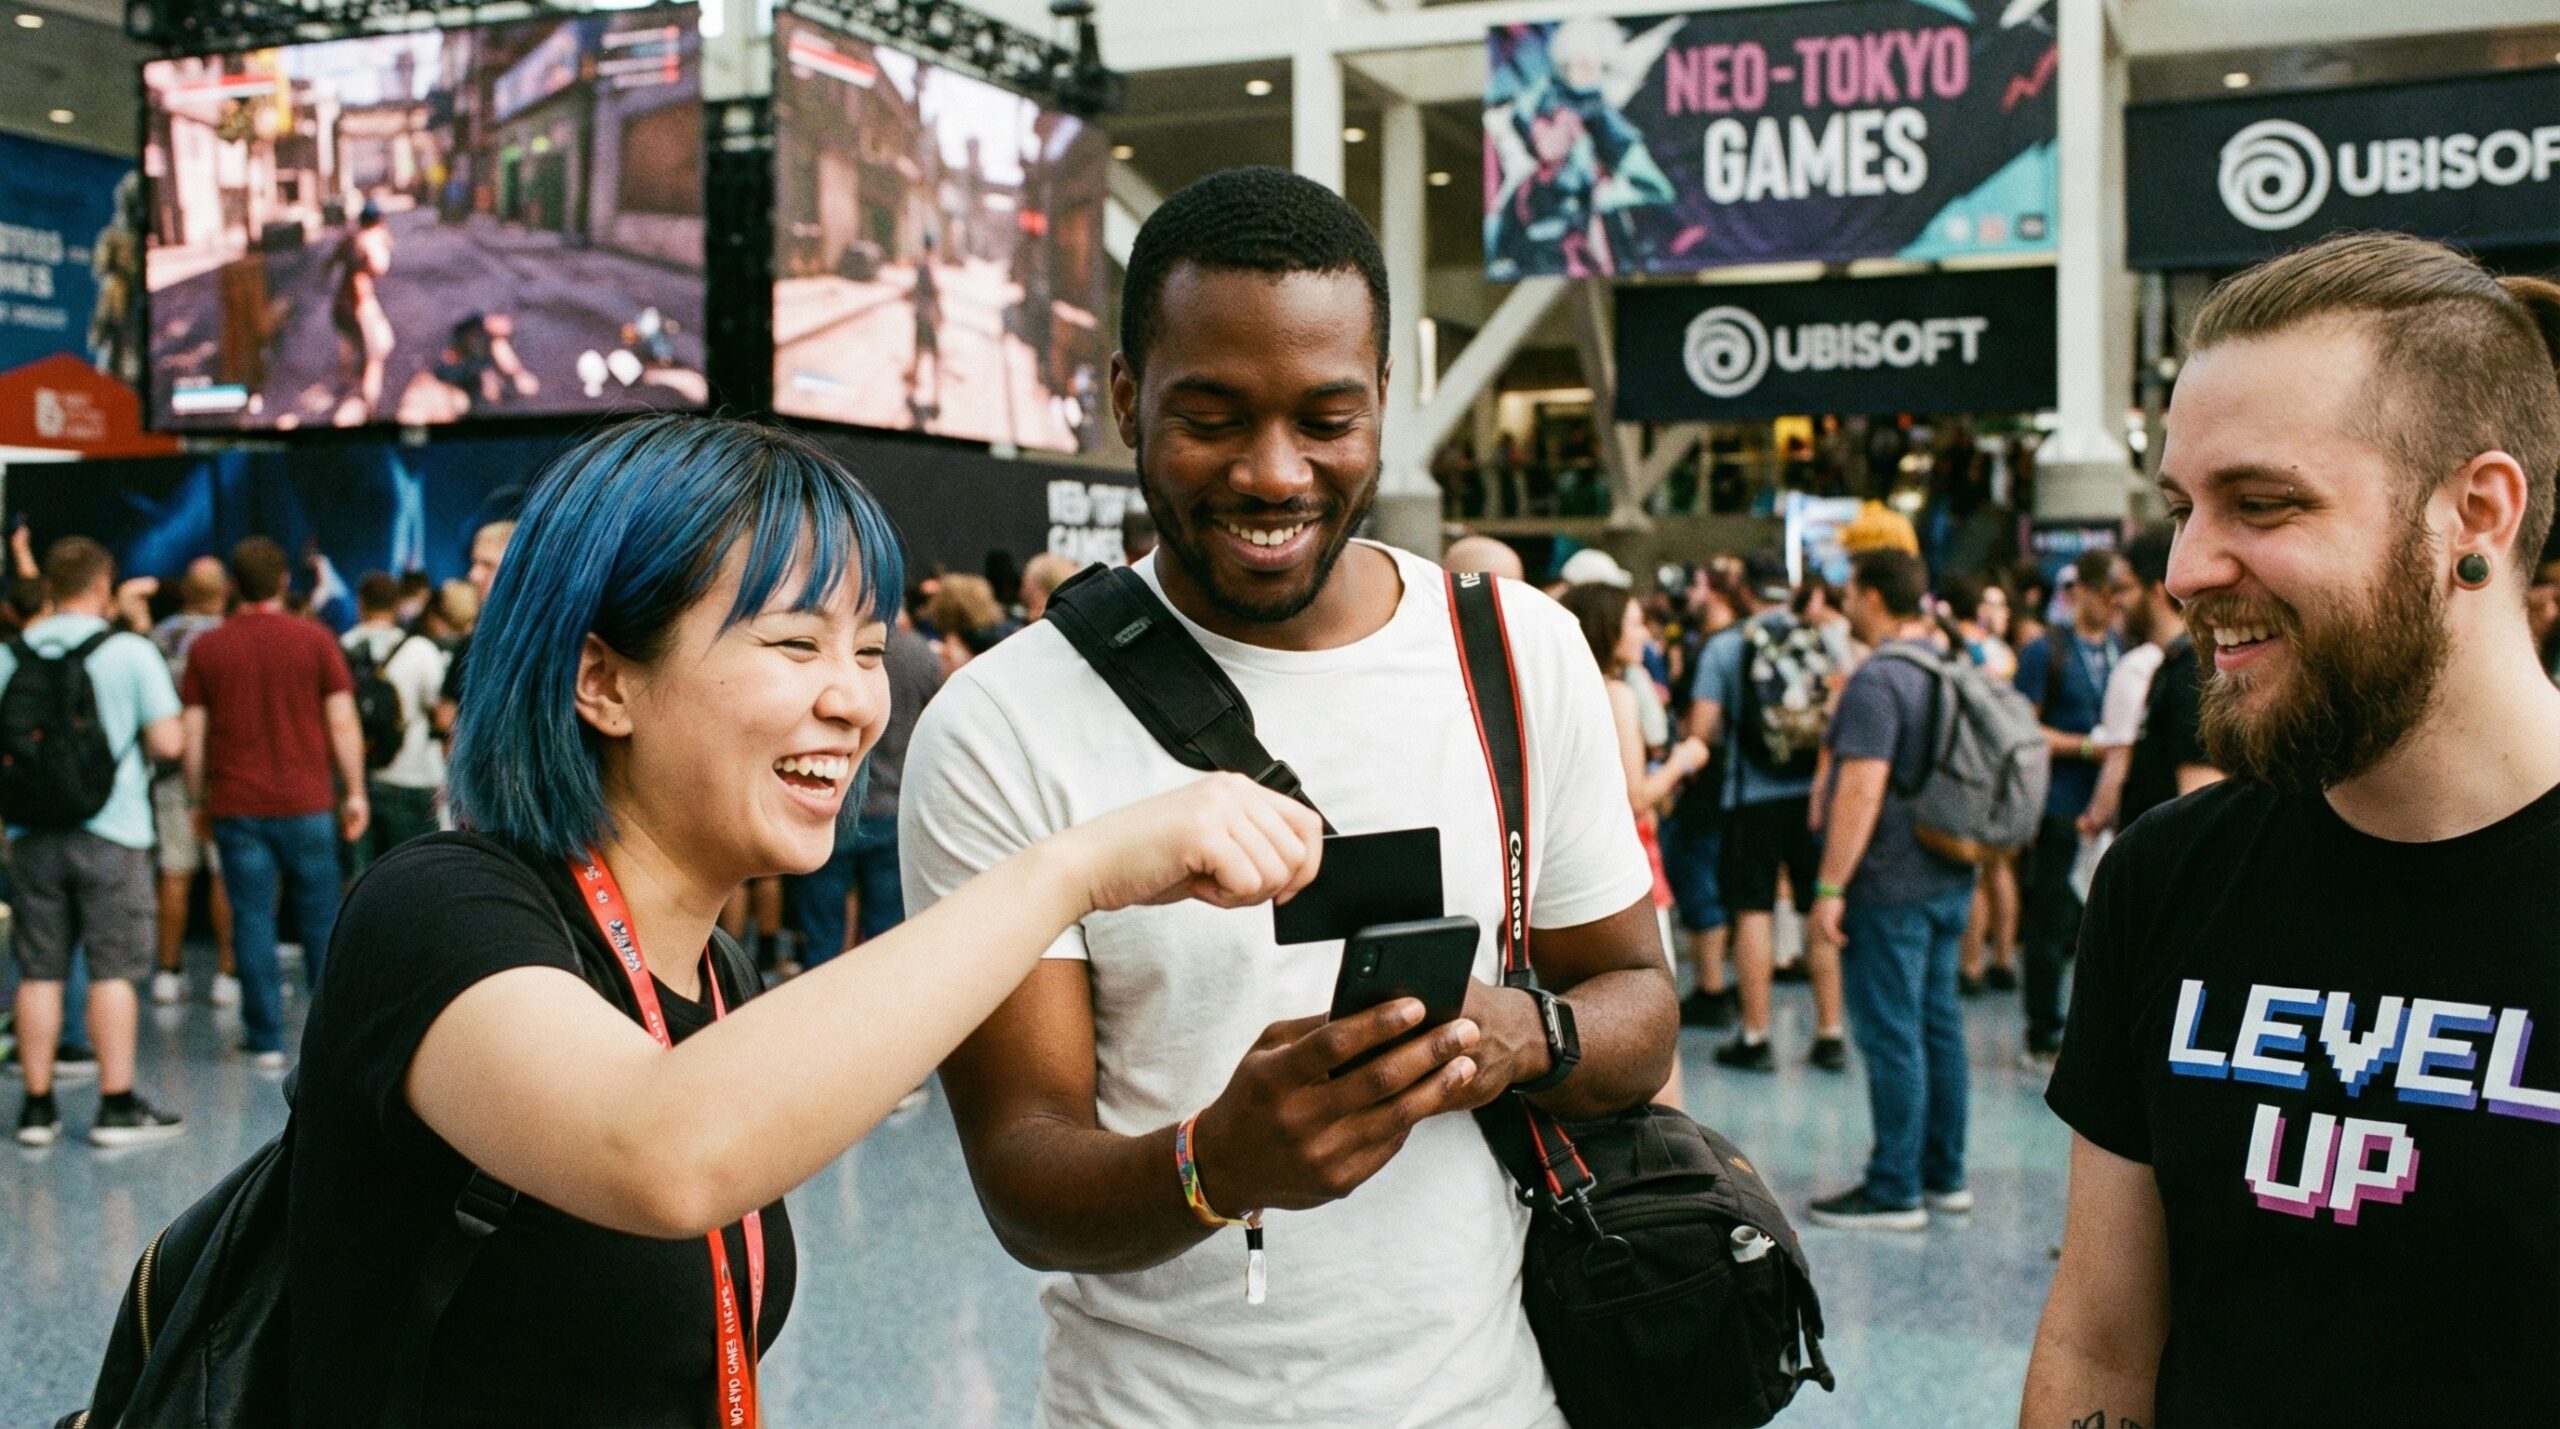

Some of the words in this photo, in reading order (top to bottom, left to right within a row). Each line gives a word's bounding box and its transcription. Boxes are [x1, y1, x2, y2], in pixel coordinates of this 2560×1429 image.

[1666, 25, 1969, 117] NEO-TOKYO
[1704, 107, 1928, 205] GAMES
[1774, 316, 1988, 374] UBISOFT
[2168, 978, 2560, 1124] LEVEL
[2244, 1103, 2420, 1226] UP
